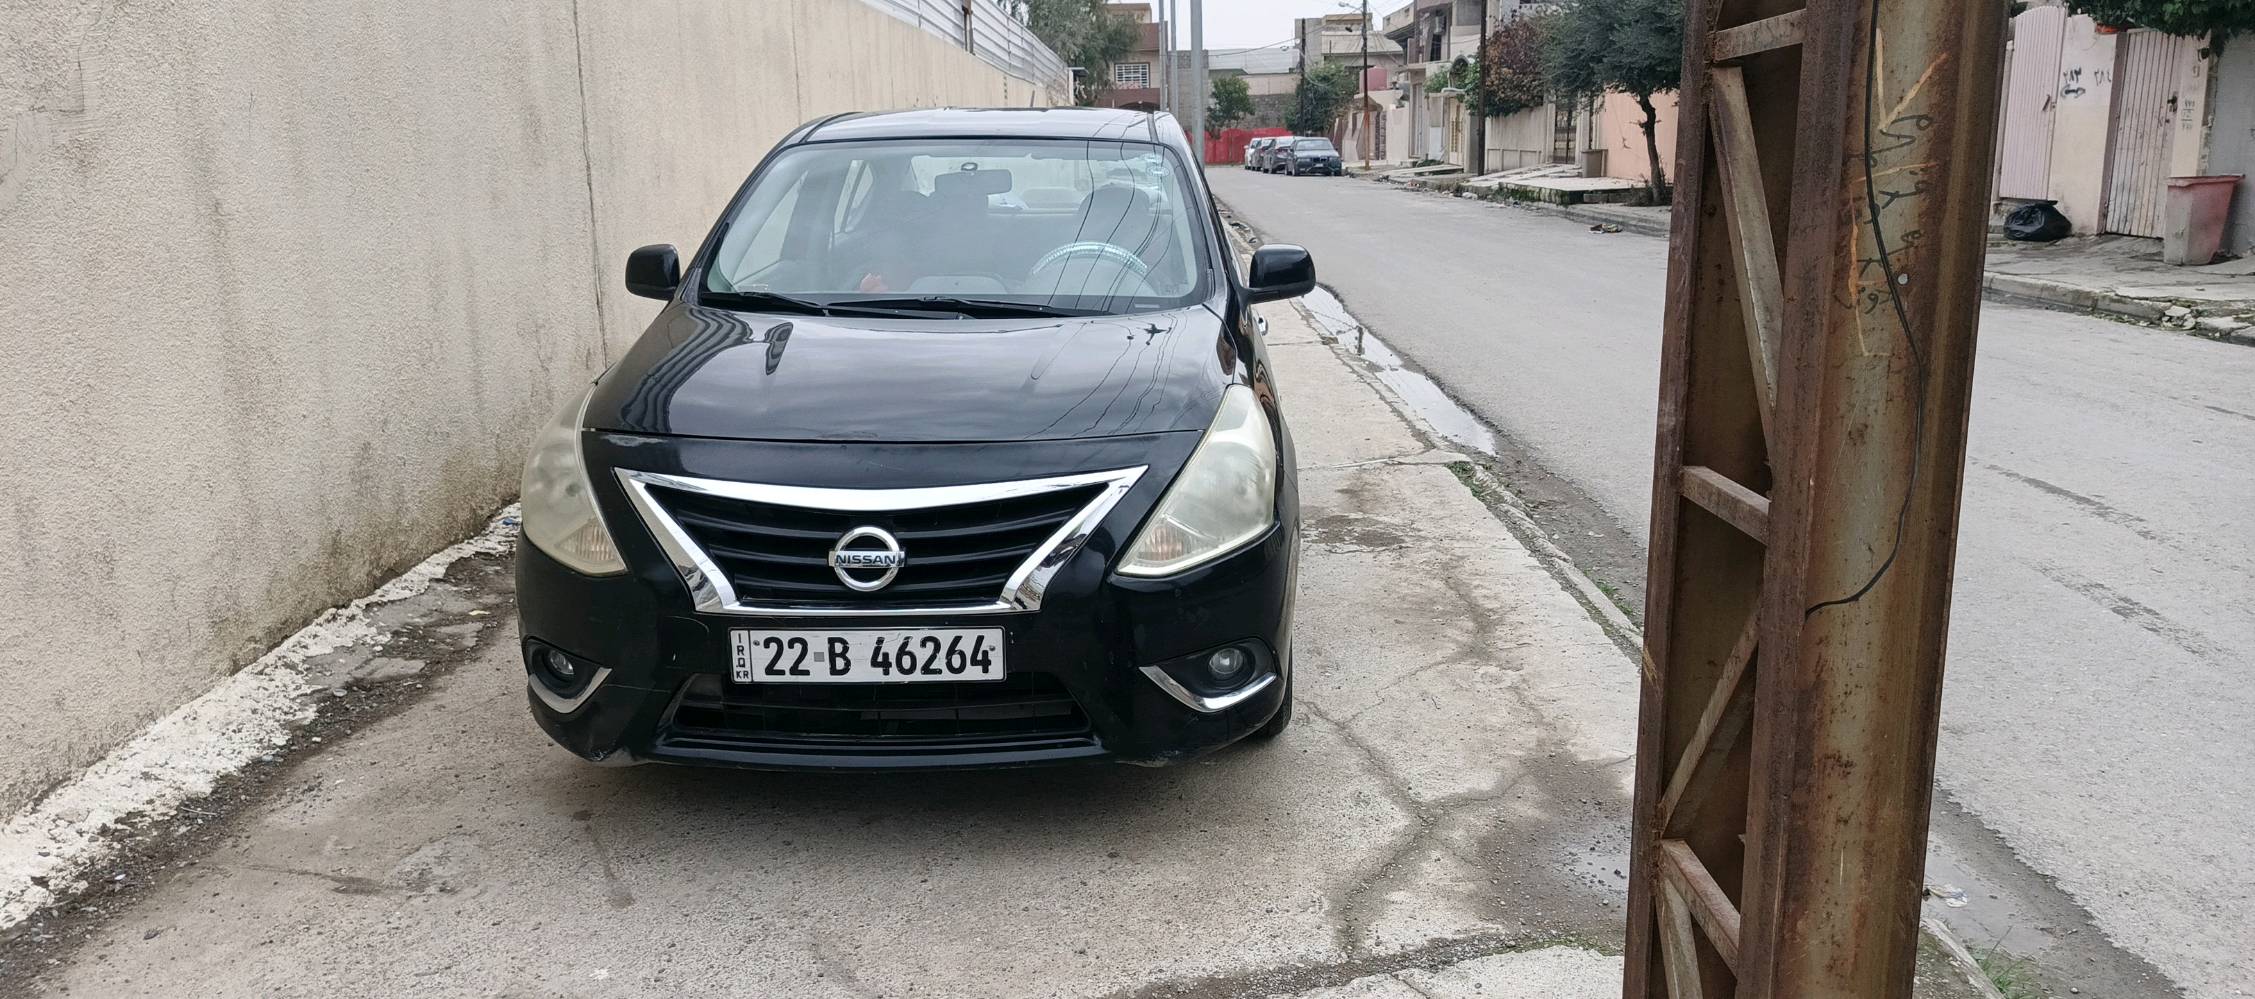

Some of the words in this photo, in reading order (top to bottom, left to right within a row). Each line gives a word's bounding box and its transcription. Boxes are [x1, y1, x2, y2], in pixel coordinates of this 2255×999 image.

[835, 554, 896, 565] NISSAN
[763, 636, 810, 676] 22
[828, 636, 852, 676] B
[870, 634, 992, 676] 46264
[736, 670, 749, 679] KR
